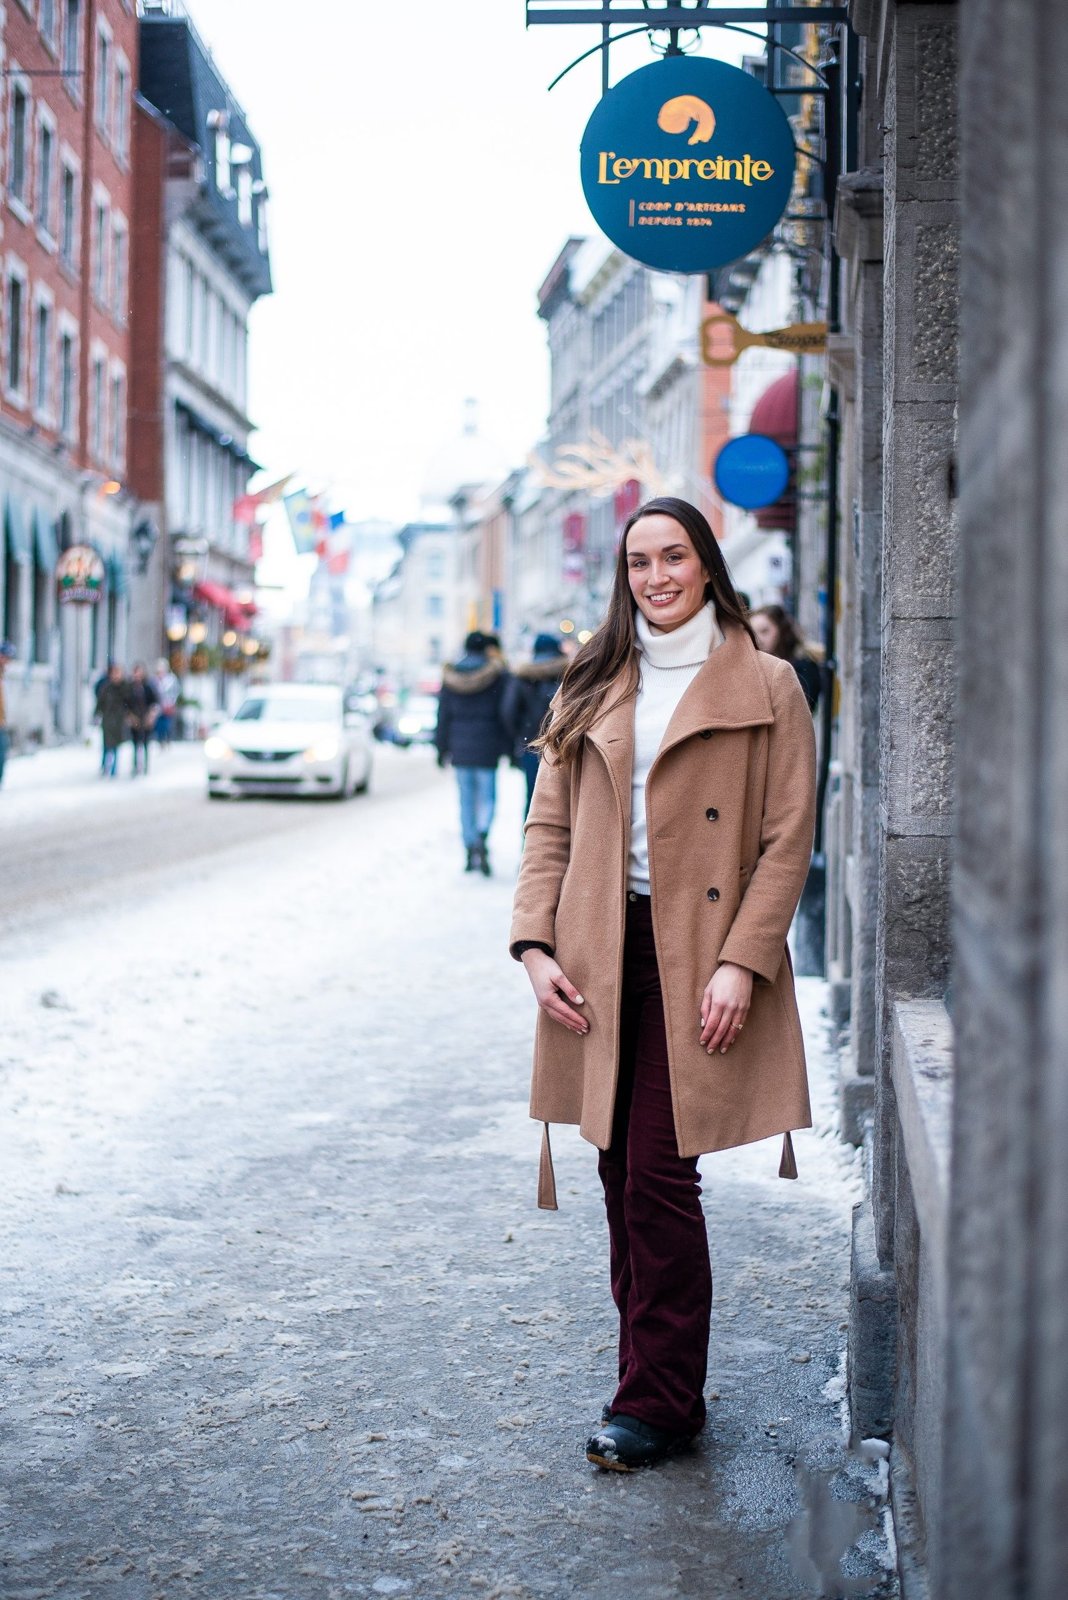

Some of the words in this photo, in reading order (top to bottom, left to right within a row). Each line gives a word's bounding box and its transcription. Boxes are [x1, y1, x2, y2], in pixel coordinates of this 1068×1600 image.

[598, 152, 775, 186] L'empreinte
[639, 202, 672, 211] COOP
[674, 202, 746, 213] D'ARTISANS
[638, 217, 683, 226] DEPUIS
